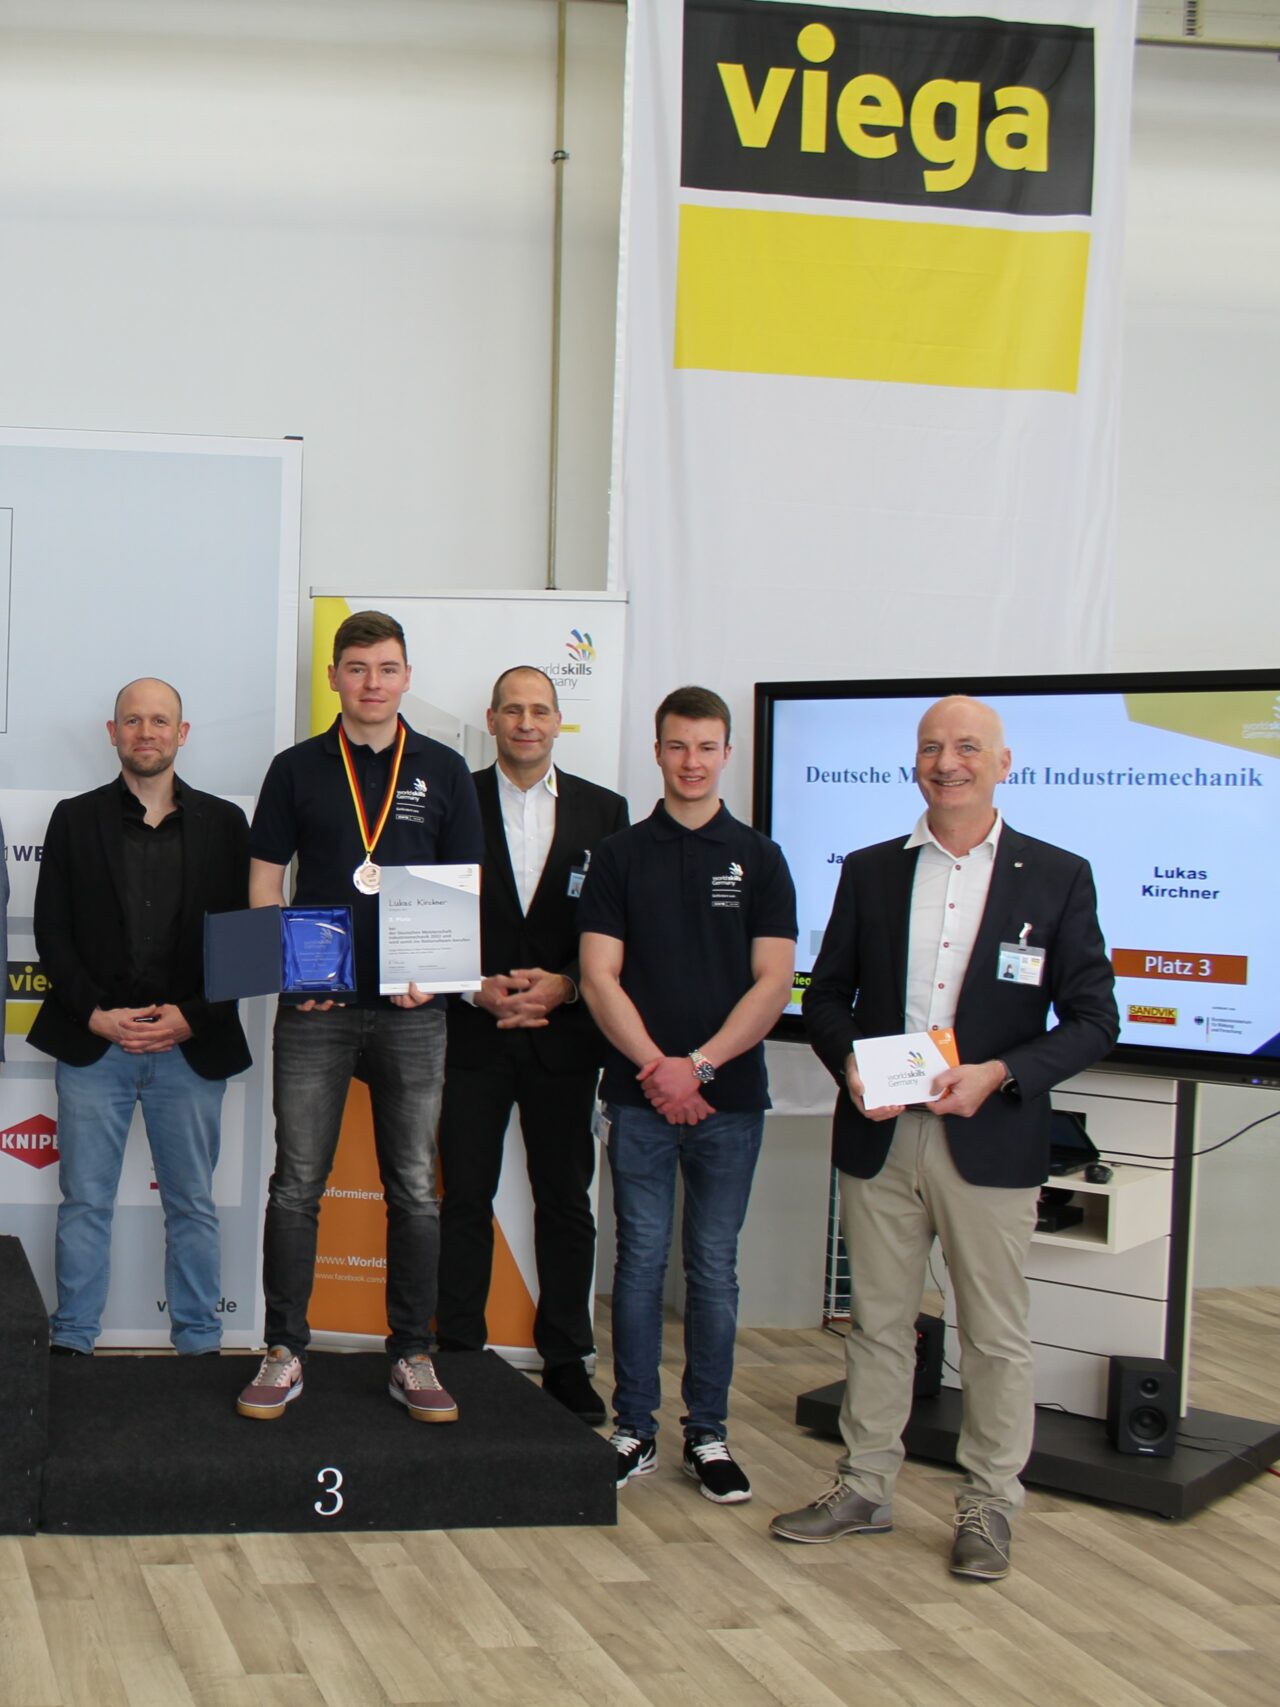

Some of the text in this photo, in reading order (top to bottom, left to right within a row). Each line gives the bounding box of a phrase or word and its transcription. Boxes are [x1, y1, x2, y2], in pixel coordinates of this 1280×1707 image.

[717, 23, 1049, 192] viega
[806, 766, 891, 783] Deutsche
[1044, 767, 1264, 787] Industriemechanik
[1154, 866, 1207, 880] Lukas
[1142, 885, 1220, 900] Kirchner
[1145, 956, 1212, 976] Platz 3
[9, 966, 52, 991] vie
[314, 1467, 344, 1515] 3
